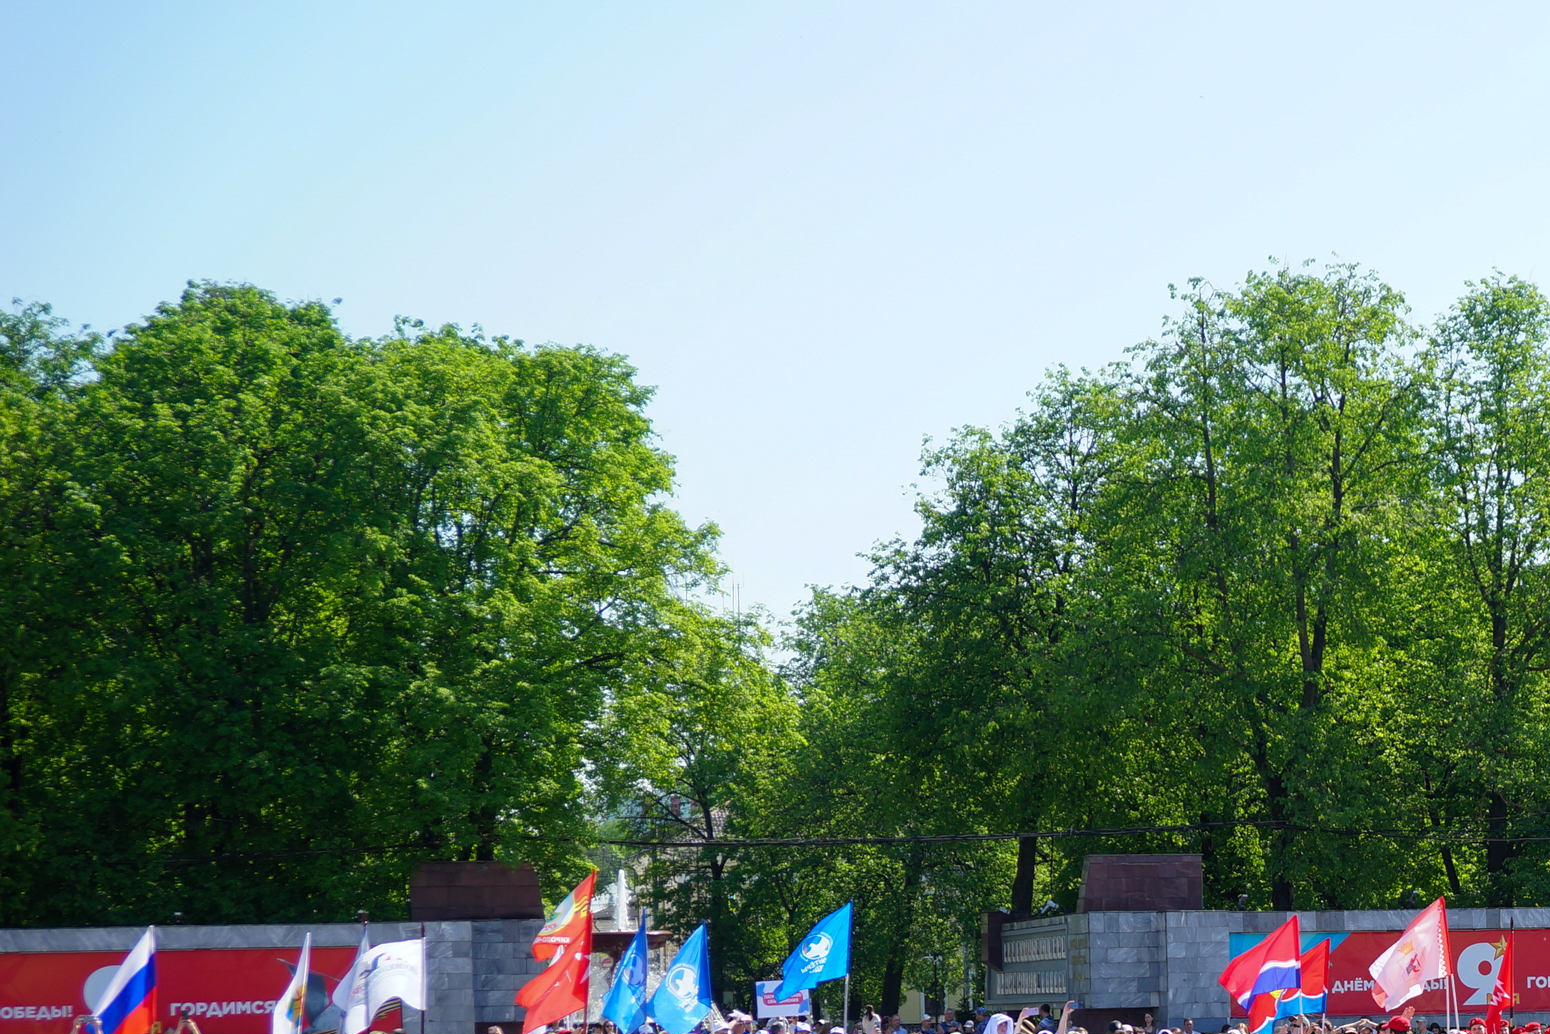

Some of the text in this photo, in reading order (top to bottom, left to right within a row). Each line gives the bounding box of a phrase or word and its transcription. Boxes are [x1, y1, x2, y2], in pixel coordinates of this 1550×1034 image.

[1332, 978, 1375, 993] ДНЁМ
[0, 1005, 74, 1021] ОБЕДЫ!
[170, 1001, 276, 1018] ГОРДИМСЯ
